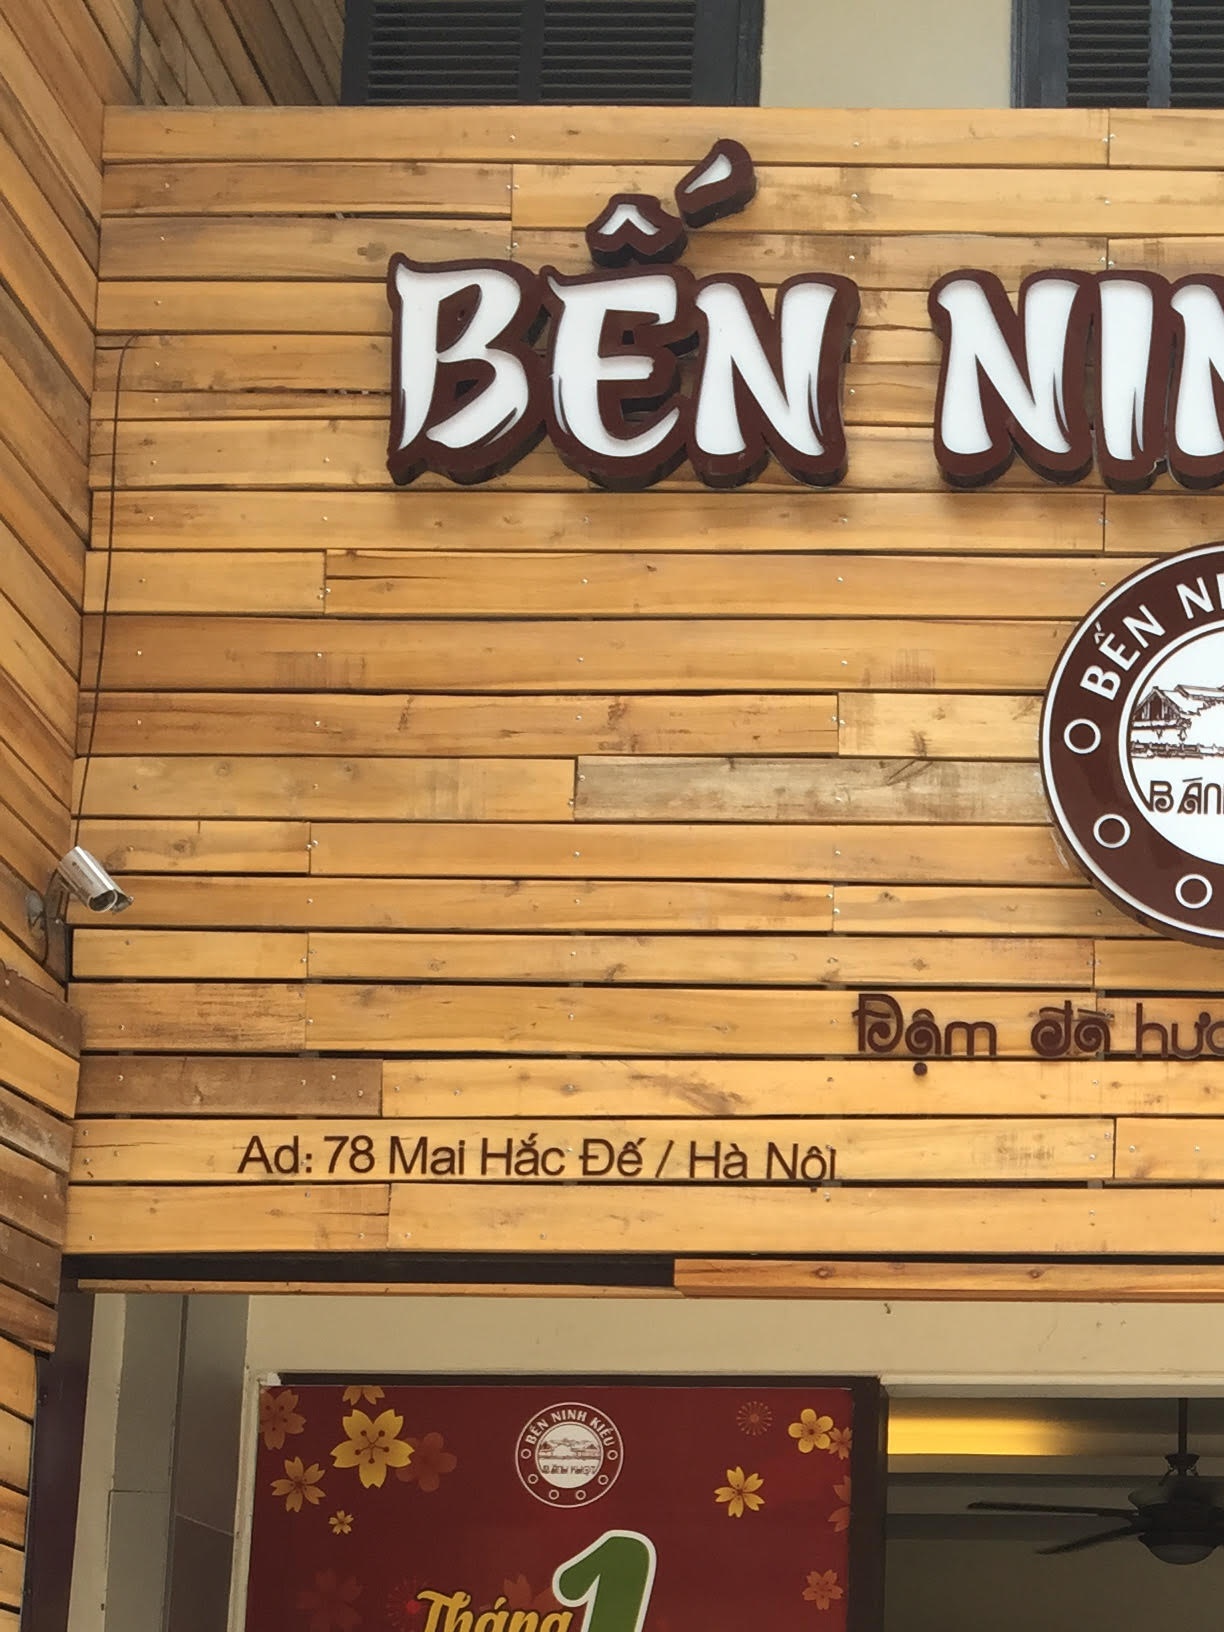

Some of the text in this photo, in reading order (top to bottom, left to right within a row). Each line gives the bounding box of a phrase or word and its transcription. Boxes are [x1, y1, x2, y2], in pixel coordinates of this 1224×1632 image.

[387, 138, 859, 490] BẾN
[1080, 602, 1166, 701] BẾN
[853, 993, 998, 1076] Đậm
[237, 1134, 313, 1175] Ad:
[322, 1134, 377, 1174] 78
[389, 1136, 466, 1176] Mai
[480, 1131, 567, 1177] Hắc
[578, 1135, 646, 1178] Đế
[688, 1136, 749, 1180] Hà
[764, 1141, 837, 1193] Nội
[551, 1409, 588, 1422] NINH
